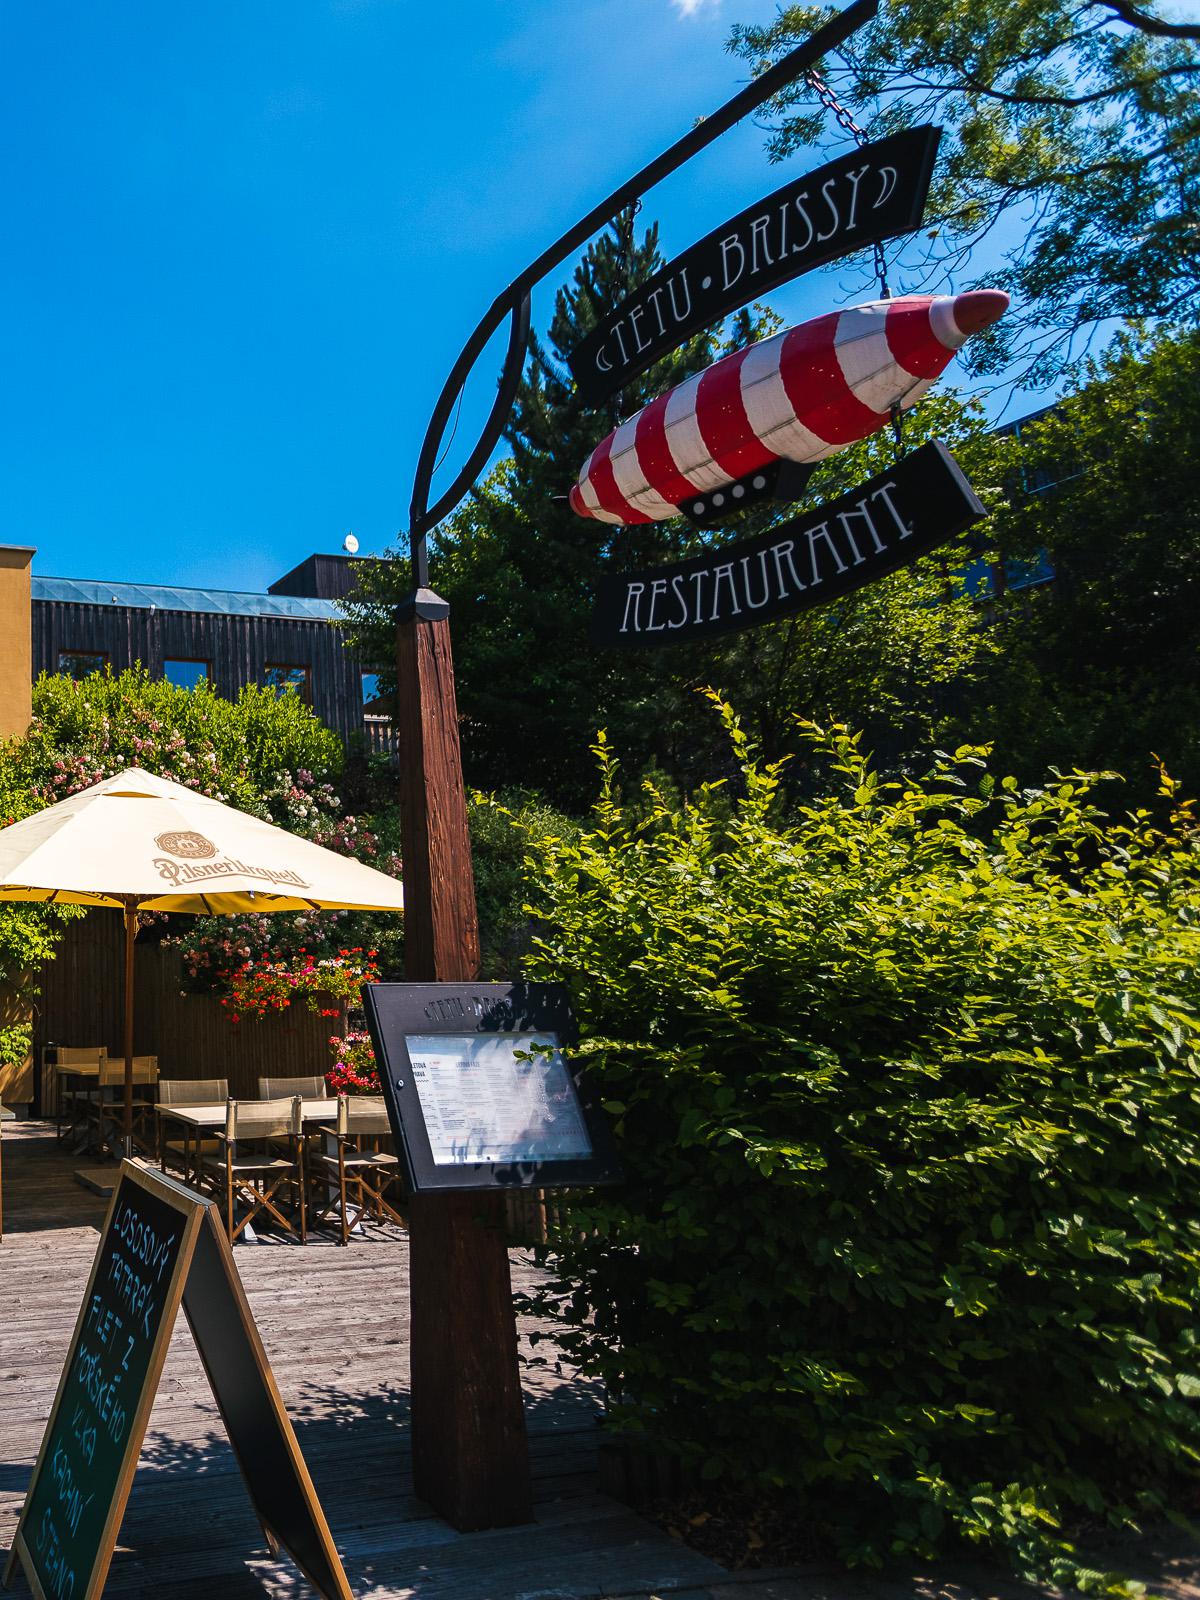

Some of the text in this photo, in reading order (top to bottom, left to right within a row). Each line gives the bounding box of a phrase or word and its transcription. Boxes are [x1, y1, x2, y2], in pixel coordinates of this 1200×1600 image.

[609, 163, 871, 367] TETU BRISSY
[619, 480, 915, 633] RESTAURANT
[151, 855, 307, 888] Pilsner Urquell
[113, 1199, 175, 1283] LOSOSOVÝ
